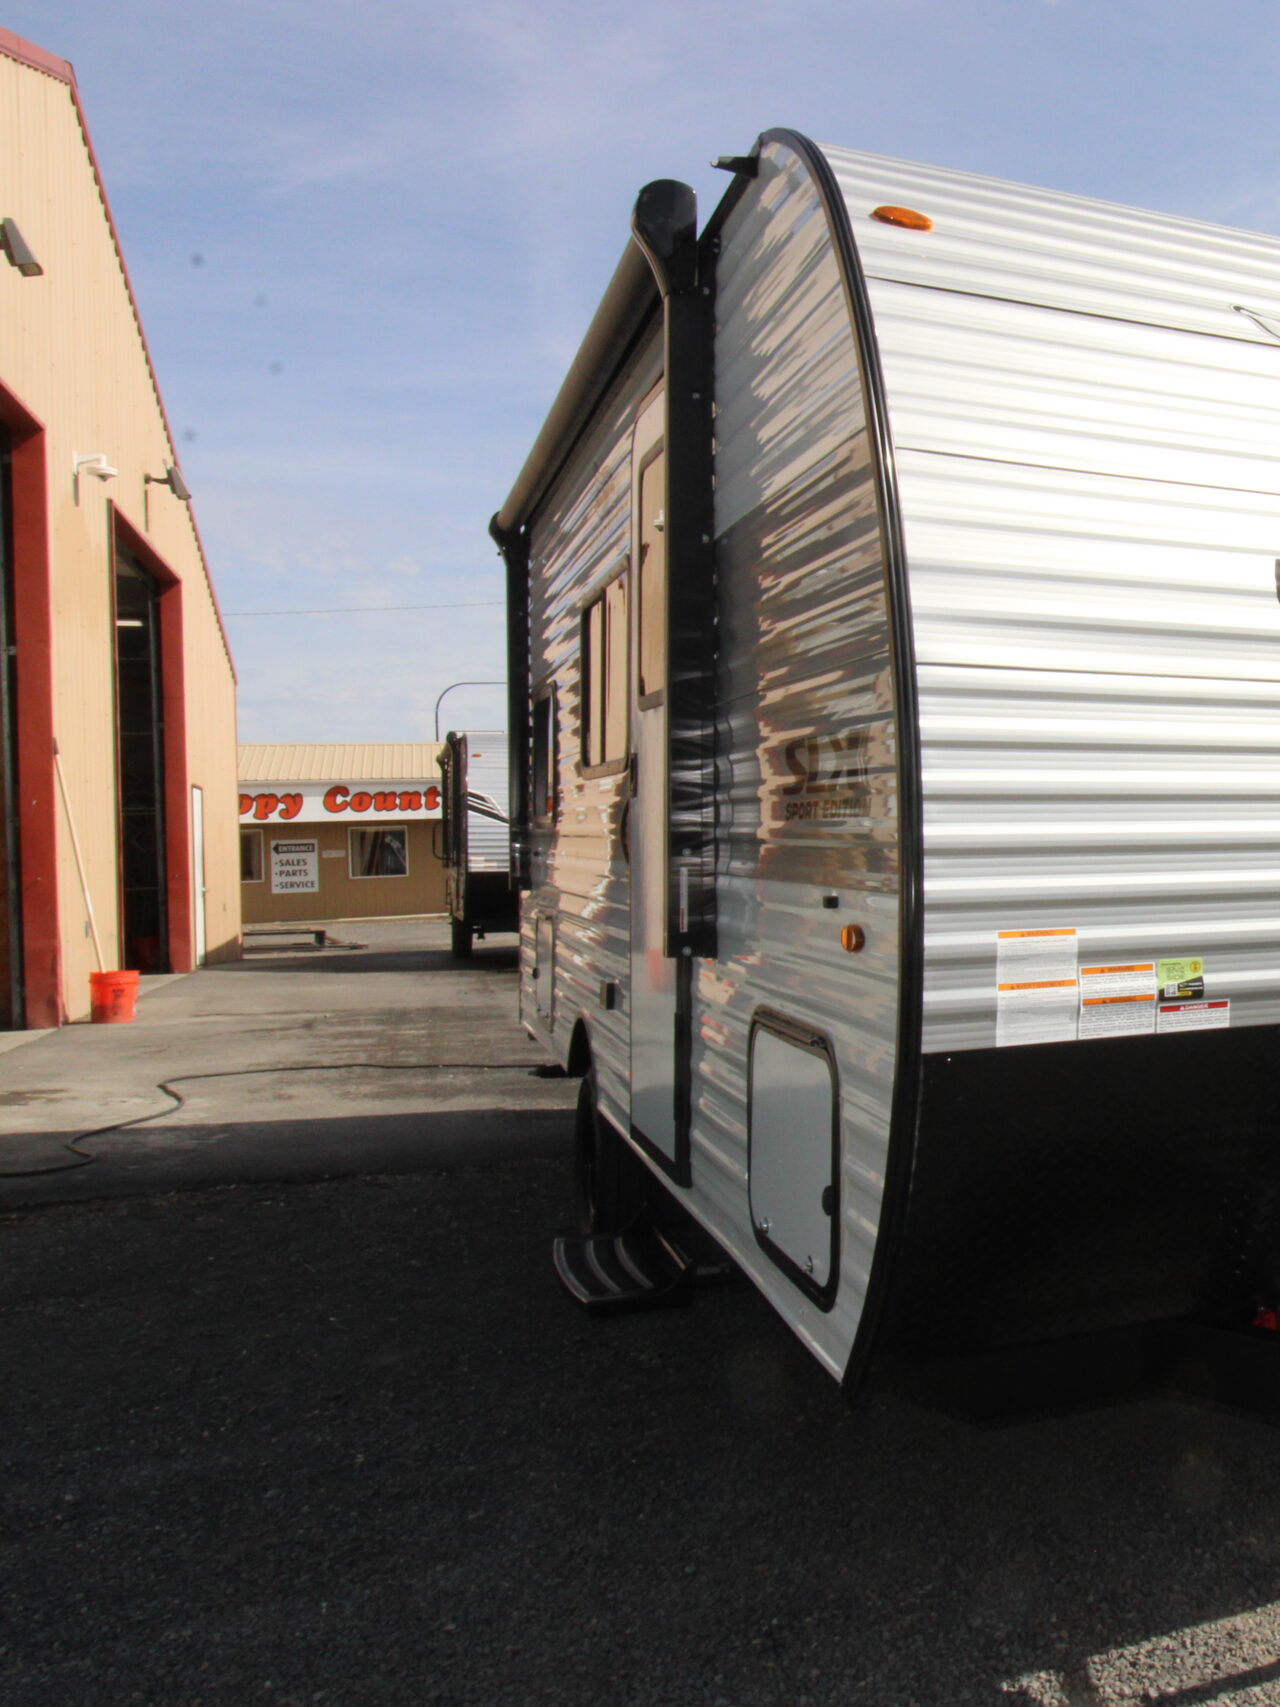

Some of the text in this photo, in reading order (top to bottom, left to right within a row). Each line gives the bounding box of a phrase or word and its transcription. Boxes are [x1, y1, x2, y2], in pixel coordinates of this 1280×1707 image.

[324, 786, 441, 813] Count
[785, 800, 820, 820] SPORT
[279, 844, 313, 852] ENTRANCE
[279, 869, 309, 877] PARTS
[279, 880, 315, 889] SERVICE
[1184, 1002, 1209, 1010] DANGER
